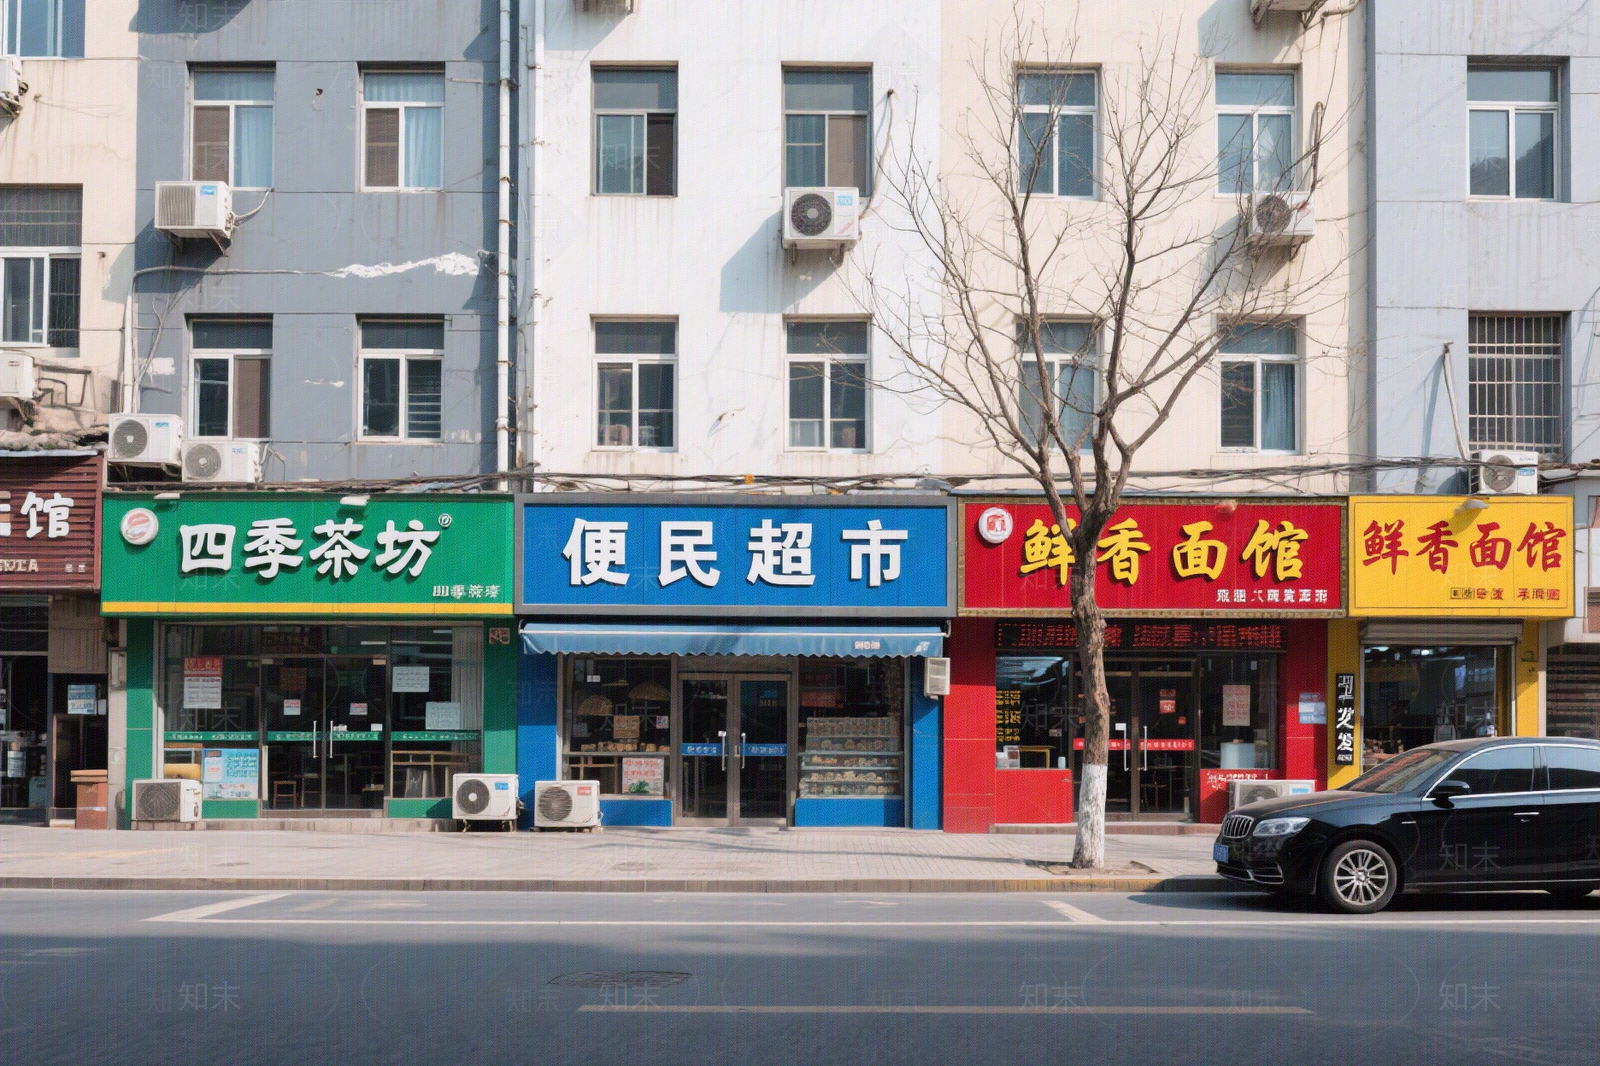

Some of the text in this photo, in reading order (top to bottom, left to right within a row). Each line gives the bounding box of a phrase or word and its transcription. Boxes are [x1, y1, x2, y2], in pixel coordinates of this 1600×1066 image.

[0, 491, 75, 539] 馆
[179, 517, 440, 578] 四季茶坊
[563, 518, 908, 587] 便民超市
[1020, 517, 1309, 586] 鲜香面馆
[1362, 519, 1567, 576] 鲜香面馆
